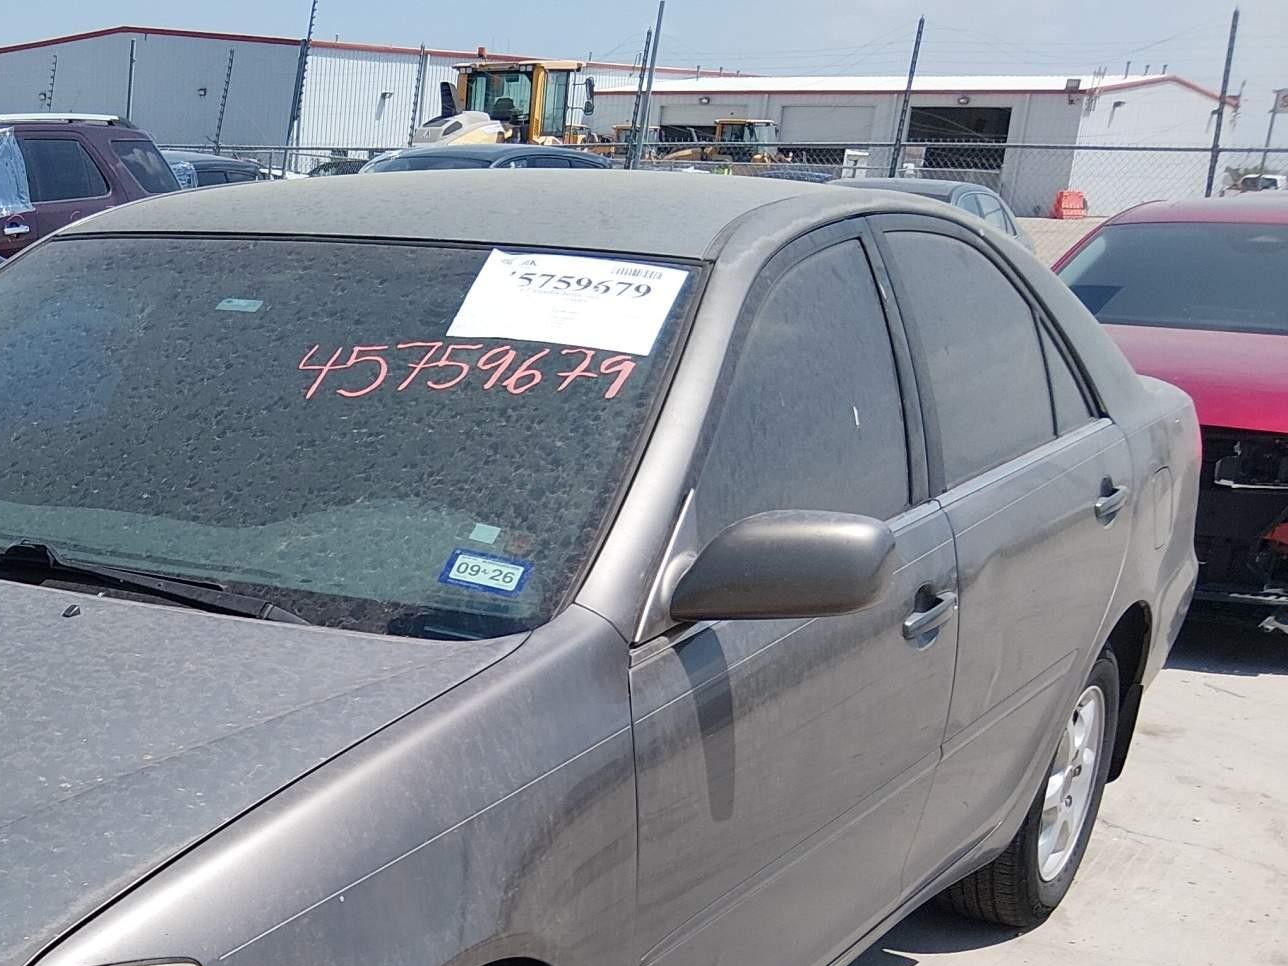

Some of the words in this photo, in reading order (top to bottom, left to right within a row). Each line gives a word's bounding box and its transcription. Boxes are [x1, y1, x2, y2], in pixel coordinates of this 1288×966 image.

[510, 271, 652, 298] 5759679
[298, 341, 636, 400] 45759679
[456, 562, 481, 577] 09
[489, 568, 515, 584] 26
